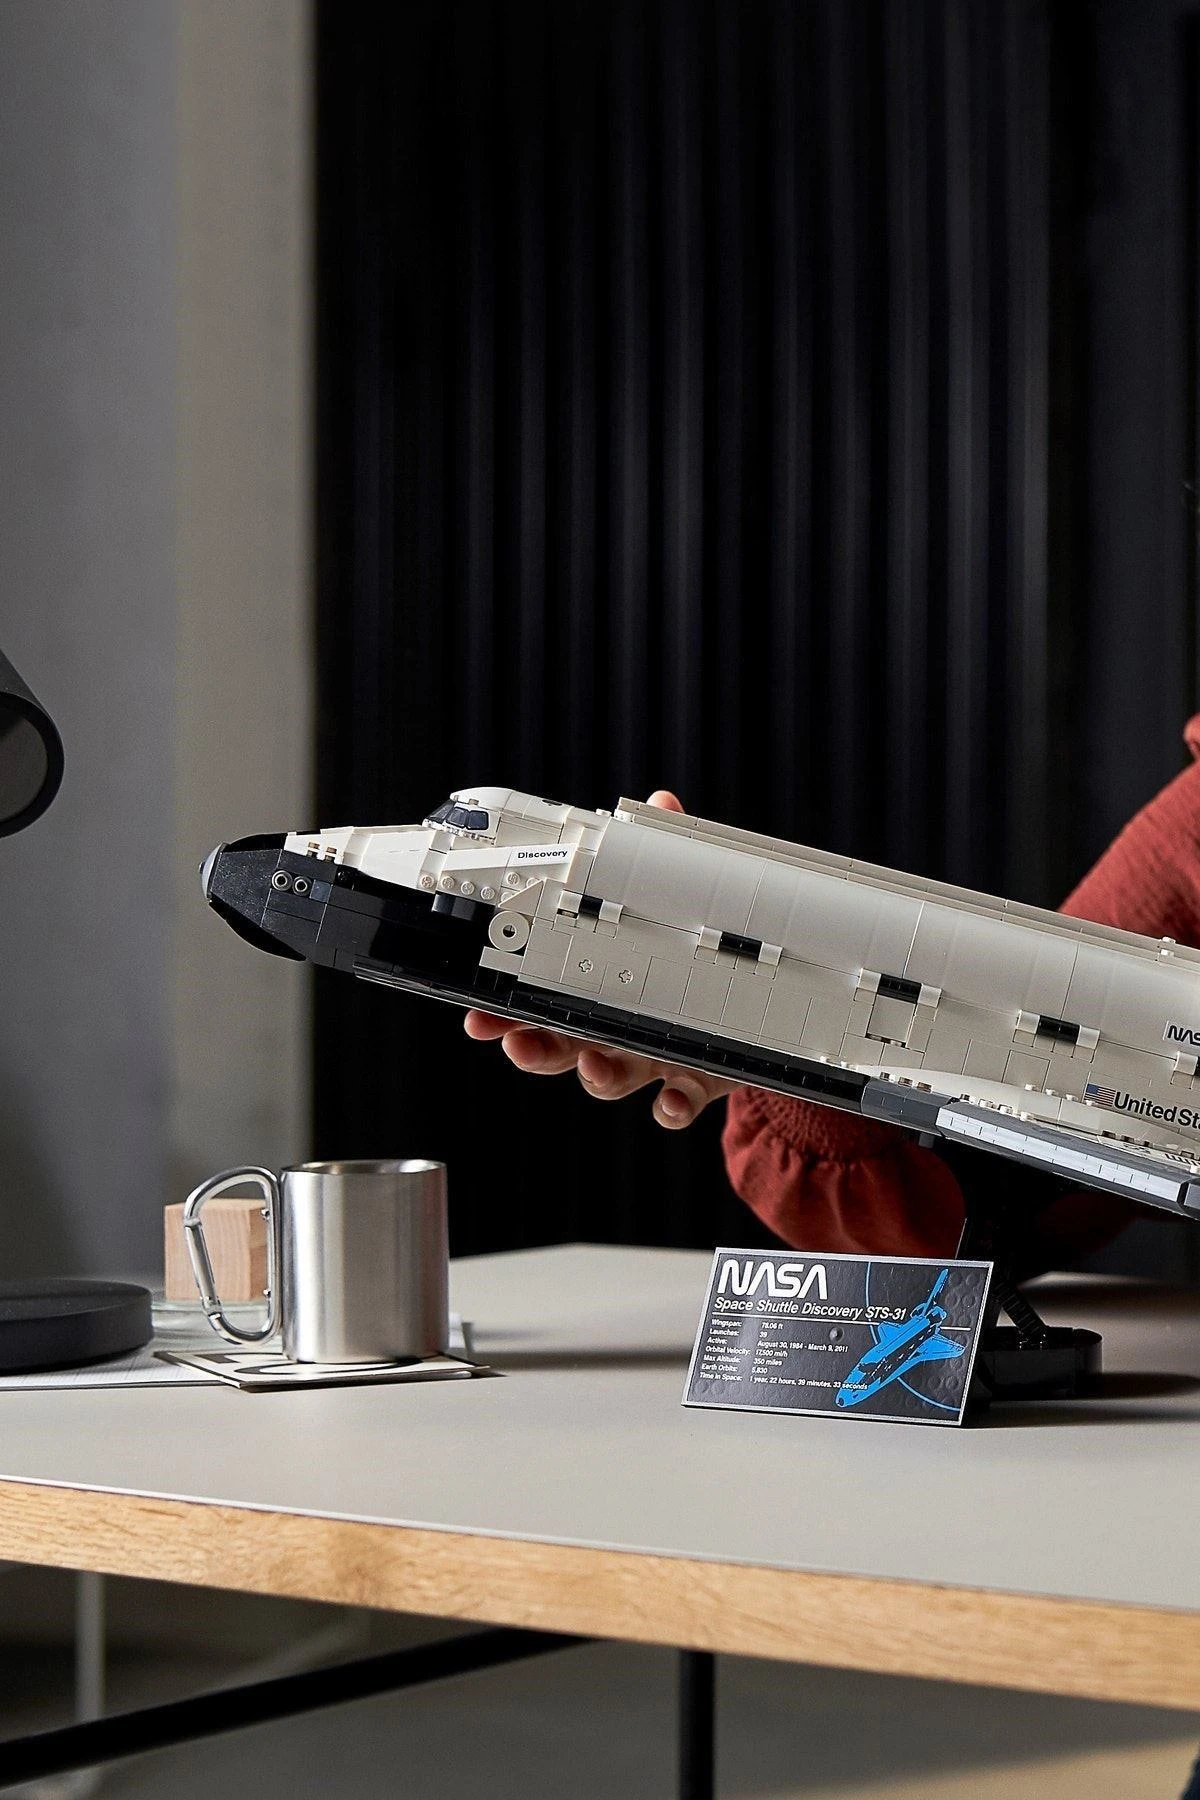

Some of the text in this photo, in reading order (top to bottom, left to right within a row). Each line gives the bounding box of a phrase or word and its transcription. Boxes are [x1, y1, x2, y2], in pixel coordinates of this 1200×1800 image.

[518, 850, 568, 859] Discovery
[1114, 1091, 1177, 1122] United
[717, 1259, 828, 1300] NASA
[714, 1296, 907, 1320] Space Shuttle Discovery STS-31
[711, 1318, 742, 1328] Wingspan:
[709, 1328, 739, 1336] Launches:
[705, 1345, 726, 1353] Orbital
[726, 1347, 751, 1355] Velocity:
[757, 1340, 779, 1349] August
[808, 1343, 827, 1351] March
[834, 1345, 848, 1353] 2011
[717, 1355, 741, 1363] Altitude:
[753, 1357, 765, 1365] 350
[765, 1358, 782, 1366] miles
[718, 1364, 738, 1372] Orbits:
[721, 1373, 743, 1381] Space:
[833, 1381, 841, 1389] 33
[842, 1382, 868, 1390] seconds
